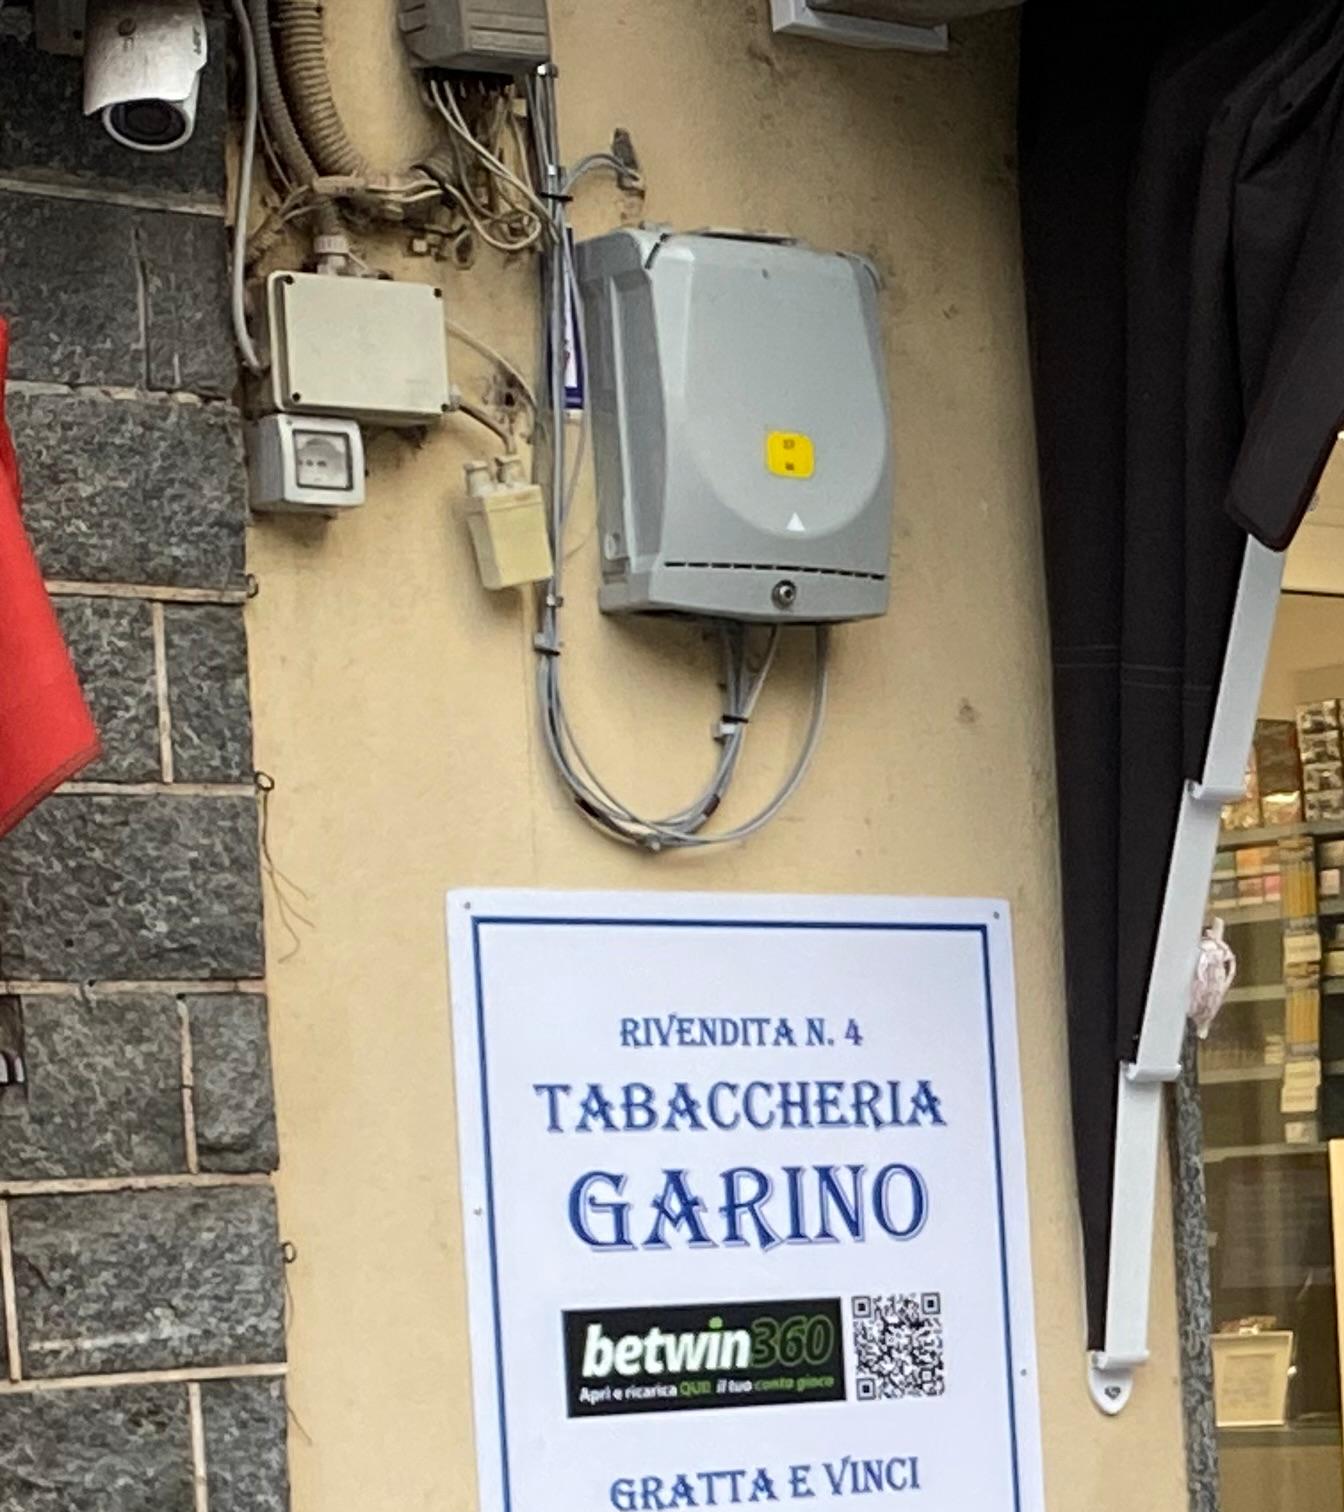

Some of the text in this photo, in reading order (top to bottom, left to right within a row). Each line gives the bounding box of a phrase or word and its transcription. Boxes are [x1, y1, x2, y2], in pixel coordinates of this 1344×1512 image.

[619, 1014, 863, 1048] RIVENDITA N. 4
[533, 1080, 947, 1132] TABACCHERIA
[567, 1163, 928, 1252] GARINO
[582, 1314, 834, 1377] betwin360
[579, 1386, 610, 1405] Apri
[613, 1388, 622, 1400] e
[624, 1382, 677, 1399] ricarica
[716, 1378, 726, 1394] il
[727, 1379, 752, 1394] tuo
[755, 1377, 794, 1391] conto
[797, 1375, 834, 1391] gioco
[789, 1465, 814, 1500] E
[822, 1455, 921, 1496] VINCI
